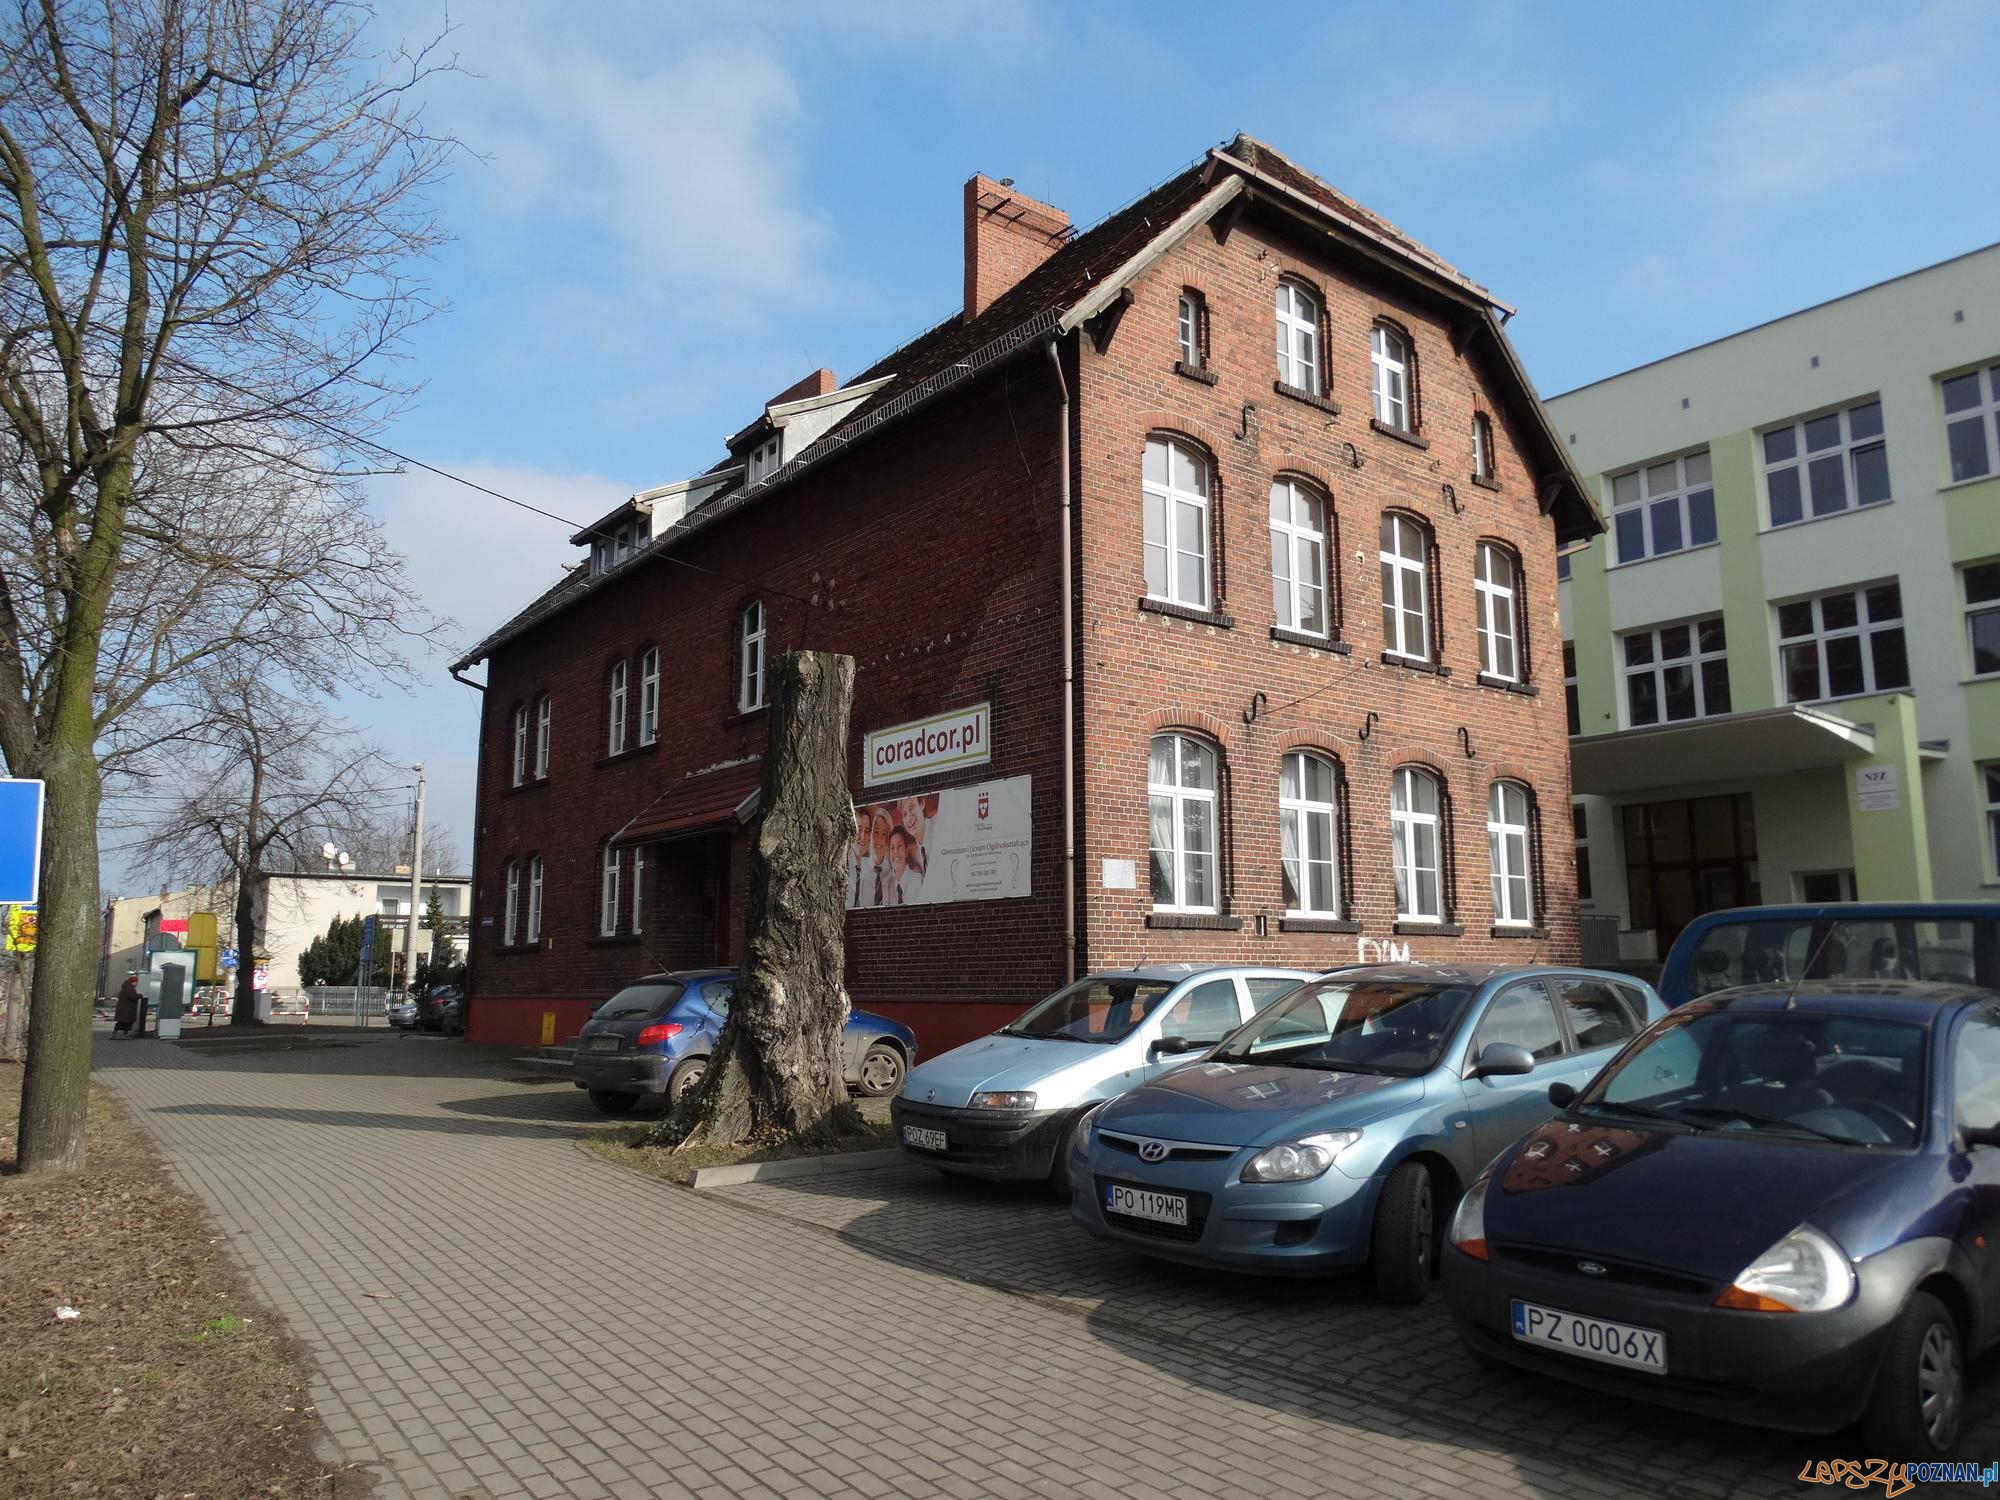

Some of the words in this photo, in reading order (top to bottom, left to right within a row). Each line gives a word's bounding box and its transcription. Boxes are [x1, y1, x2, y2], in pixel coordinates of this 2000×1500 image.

[876, 714, 981, 766] coradcor.pl
[906, 1126, 924, 1143] POZ
[925, 1130, 945, 1147] 69EF
[1115, 1187, 1134, 1209] PO
[1139, 1192, 1185, 1219] 119MR
[1528, 1308, 1563, 1343] PZ
[1572, 1319, 1659, 1365] 0006X
